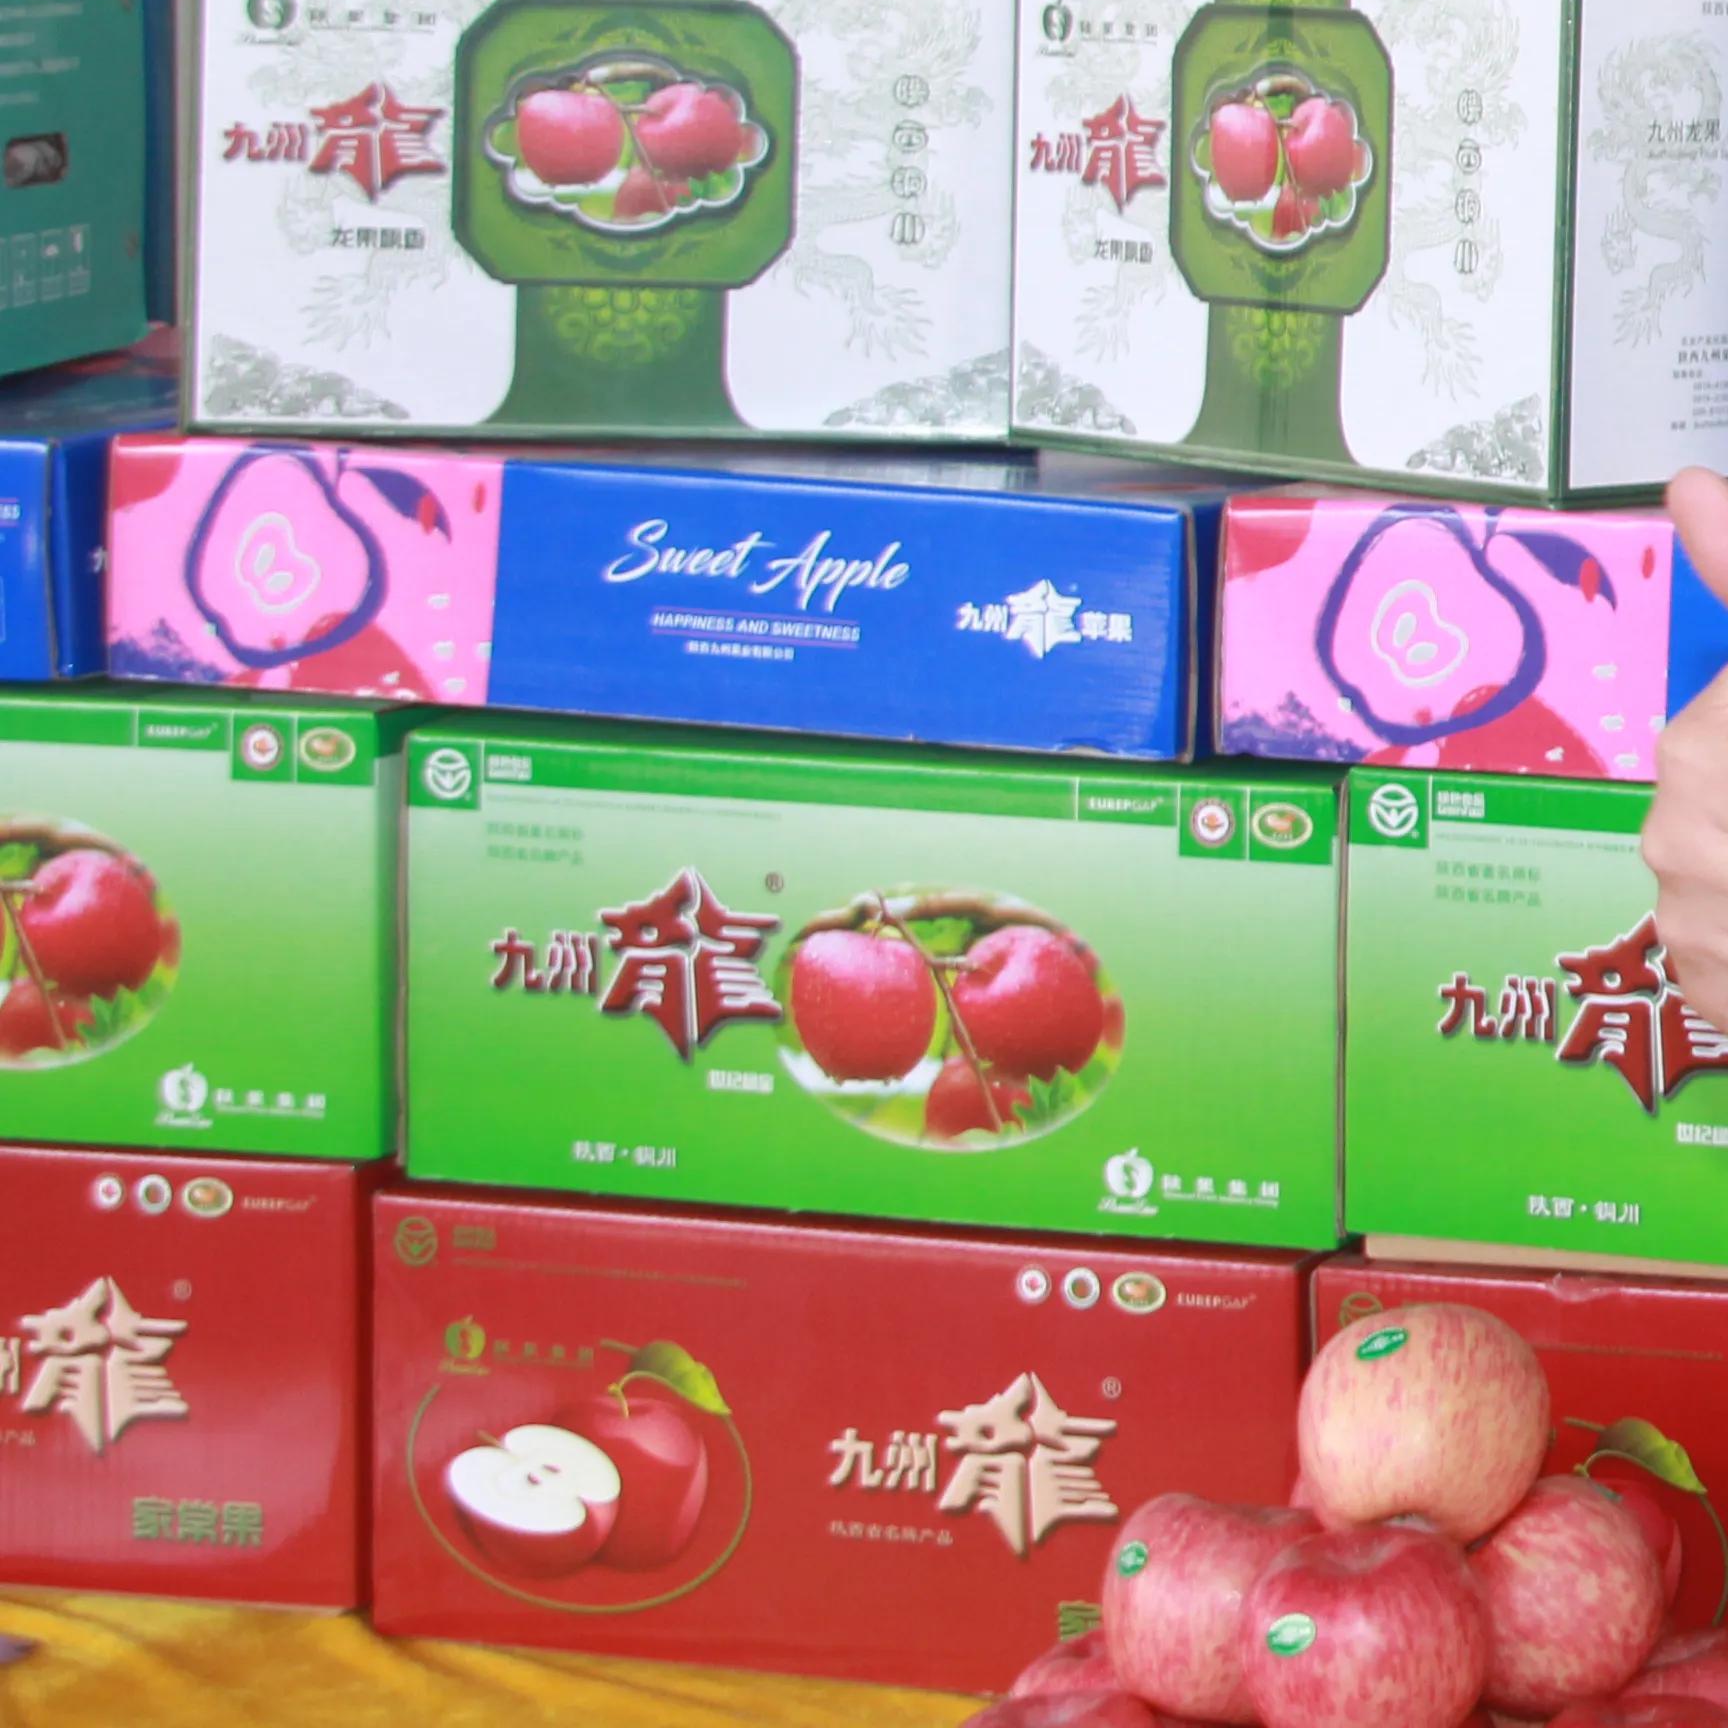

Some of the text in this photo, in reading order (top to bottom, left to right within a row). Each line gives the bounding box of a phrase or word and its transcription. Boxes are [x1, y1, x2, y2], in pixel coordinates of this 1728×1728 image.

[605, 518, 910, 613] Sweet Apple
[653, 613, 861, 642] HAPPINESS AND SWEETNESS
[132, 1496, 263, 1547] 家常果
